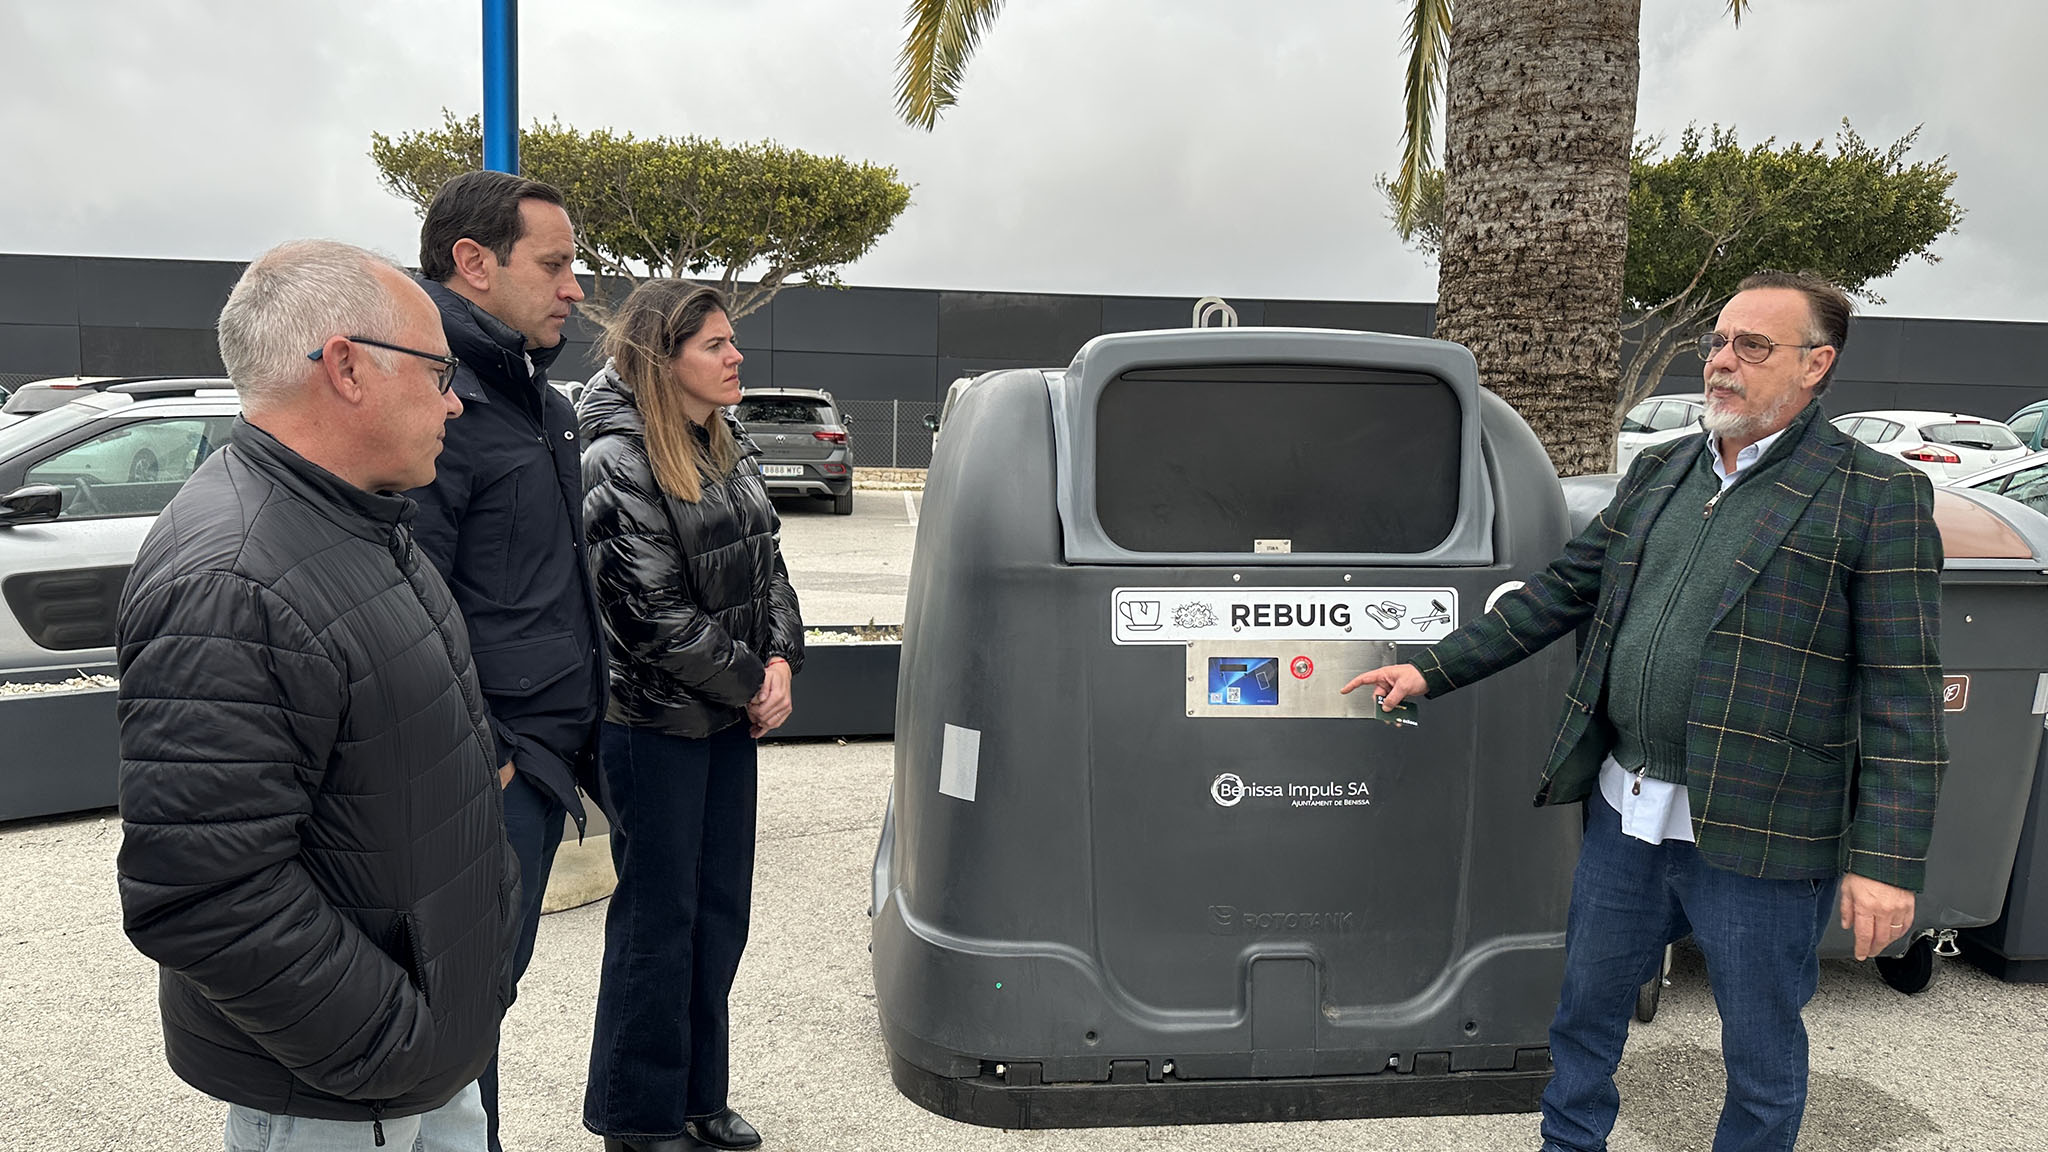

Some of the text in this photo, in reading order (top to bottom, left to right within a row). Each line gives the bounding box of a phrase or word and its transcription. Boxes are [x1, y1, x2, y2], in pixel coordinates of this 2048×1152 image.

[1231, 604, 1351, 627] REBUIG
[1221, 781, 1369, 800] Benissa Impuls SA
[1243, 912, 1353, 929] ROTOTANK
